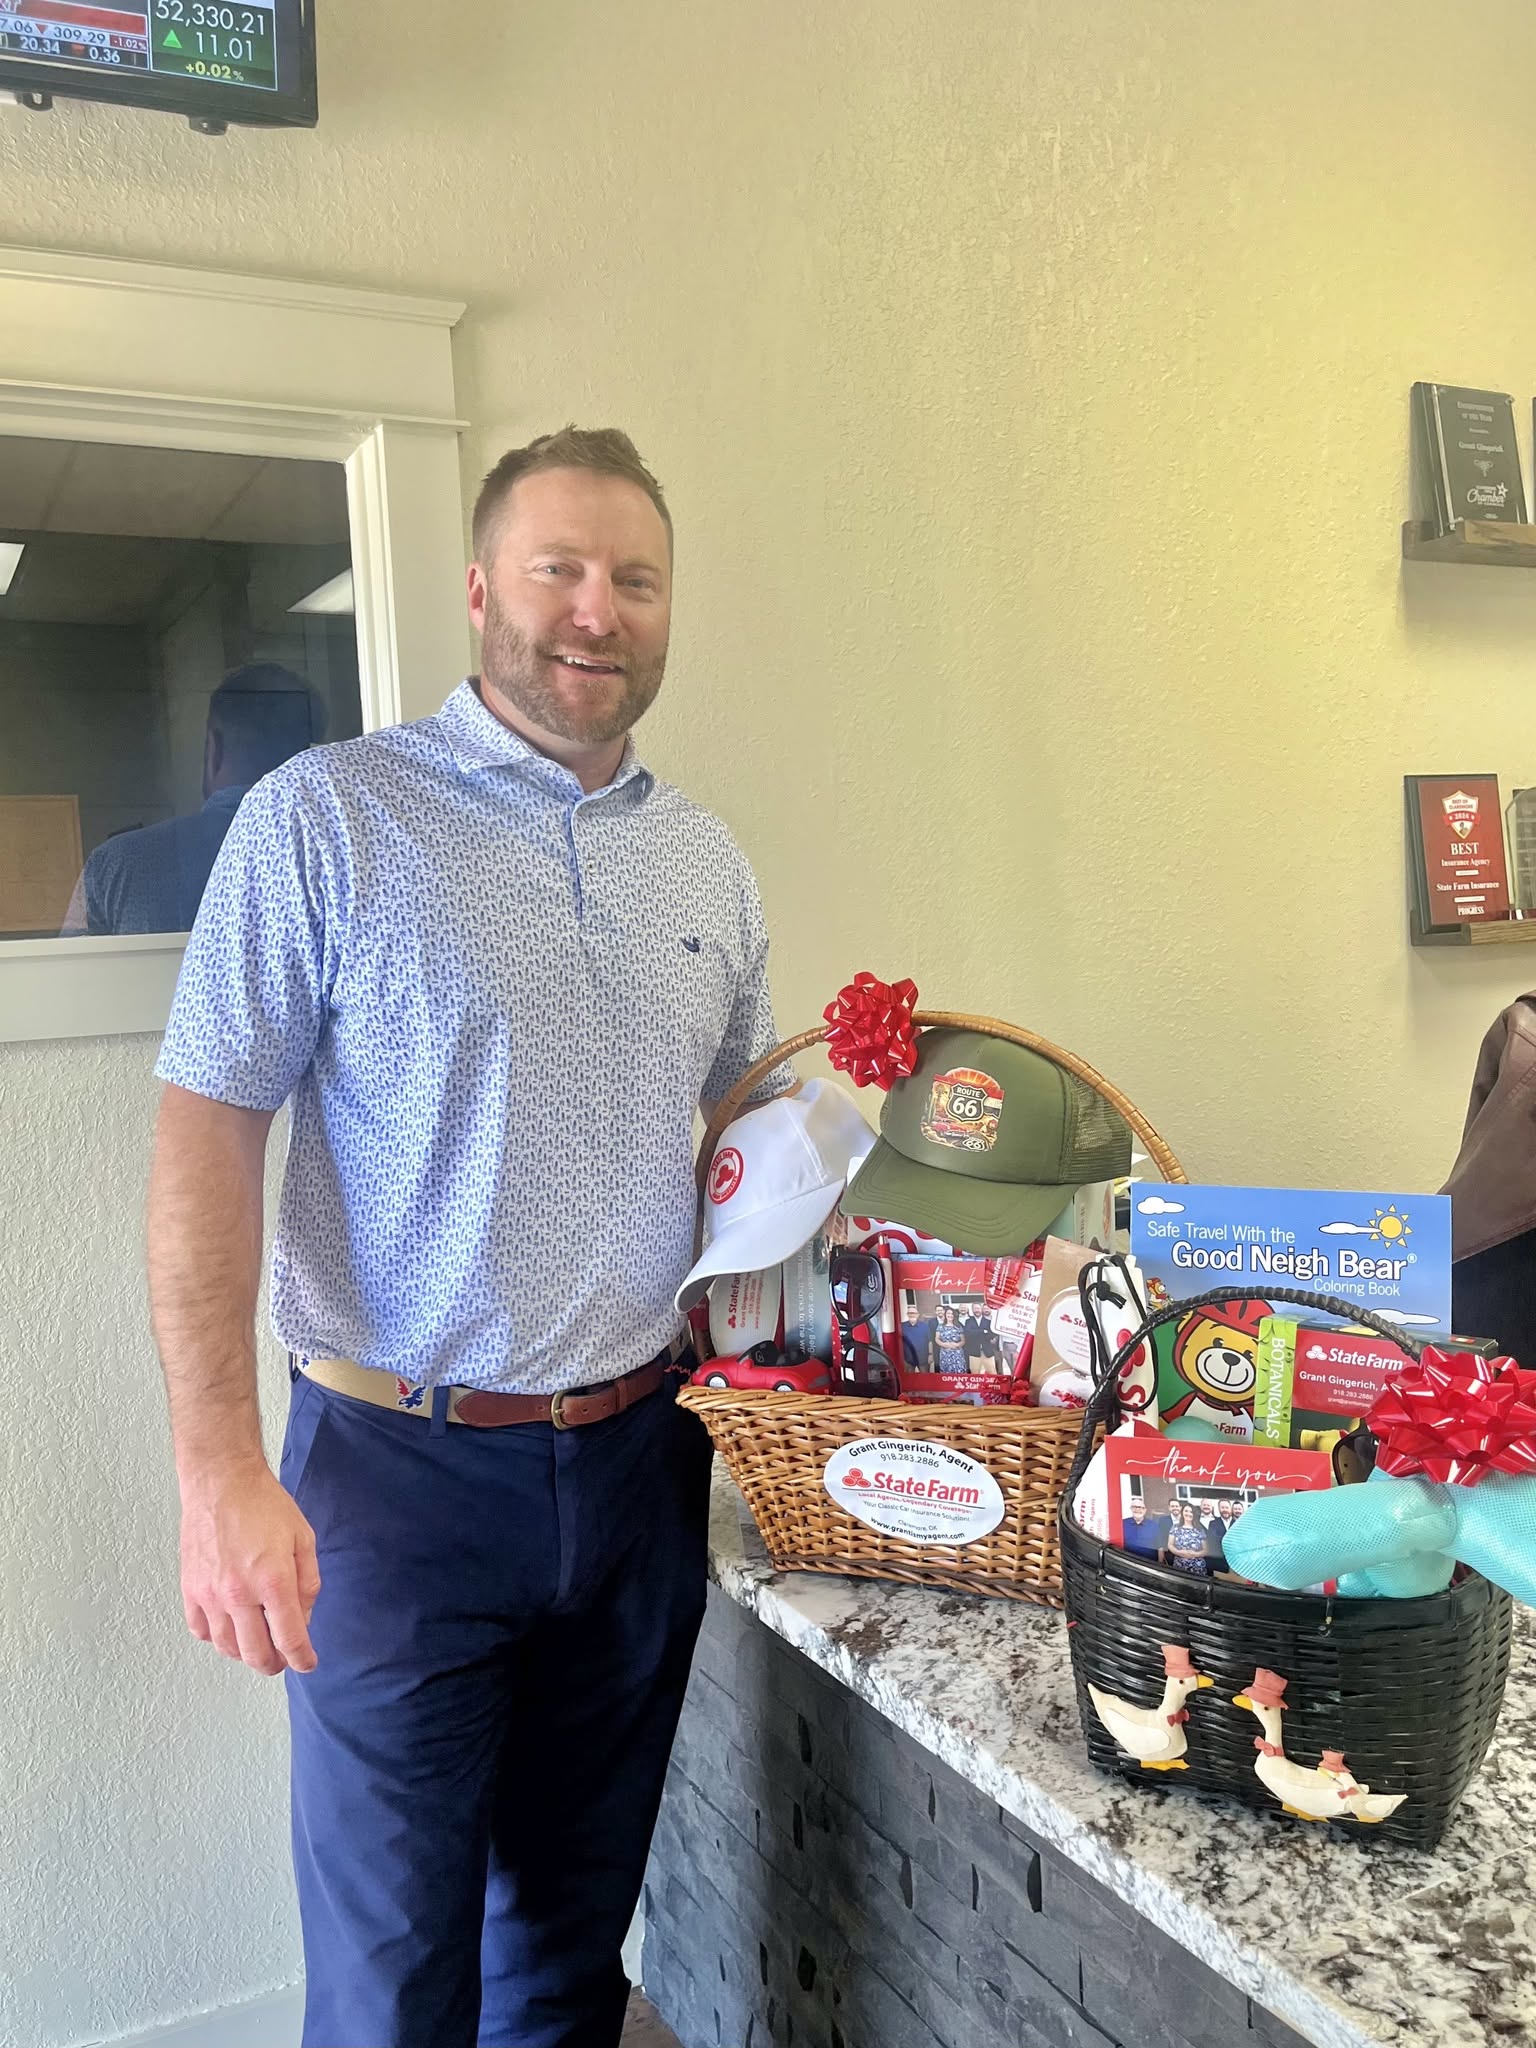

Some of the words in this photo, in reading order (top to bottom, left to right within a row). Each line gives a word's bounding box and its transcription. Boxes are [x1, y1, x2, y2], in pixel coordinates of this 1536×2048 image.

[156, 0, 264, 36] 52,330.21
[53, 26, 106, 44] 309.29
[20, 36, 60, 54] 20.34
[89, 48, 121, 64] 0.36
[196, 31, 253, 62] 11.01
[1450, 842, 1479, 856] BEST
[1441, 859, 1469, 867] Insurance
[1471, 858, 1490, 867] Agency
[1436, 883, 1453, 892] State
[1453, 882, 1470, 890] Farm
[1471, 881, 1500, 890] Insurance
[956, 1087, 982, 1098] ROUTE
[952, 1097, 978, 1117] 66
[1147, 1220, 1180, 1238] Safe
[1184, 1222, 1228, 1241] Travel
[1232, 1224, 1266, 1243] With
[1270, 1227, 1296, 1244] the
[1171, 1240, 1244, 1272] Good
[1250, 1244, 1330, 1281] Neigh
[902, 1266, 982, 1294] thank
[1313, 1278, 1366, 1297] Coloring
[1368, 1281, 1401, 1297] Book
[942, 1375, 968, 1383] GRANT
[1266, 1337, 1287, 1440] BOTANICALS
[1299, 1370, 1327, 1383] Grant
[1328, 1375, 1379, 1392] Gingerich,
[849, 1443, 878, 1457] Grant
[878, 1440, 937, 1456] Gingerich,
[939, 1449, 974, 1473] Agent
[880, 1453, 940, 1468] 918.283.2886
[1125, 1445, 1229, 1486] thank
[1237, 1463, 1312, 1496] you
[877, 1502, 899, 1512] Classic
[900, 1505, 910, 1513] Car
[911, 1508, 941, 1518] Insurance
[871, 1516, 965, 1540] www.grantismyagent.com
